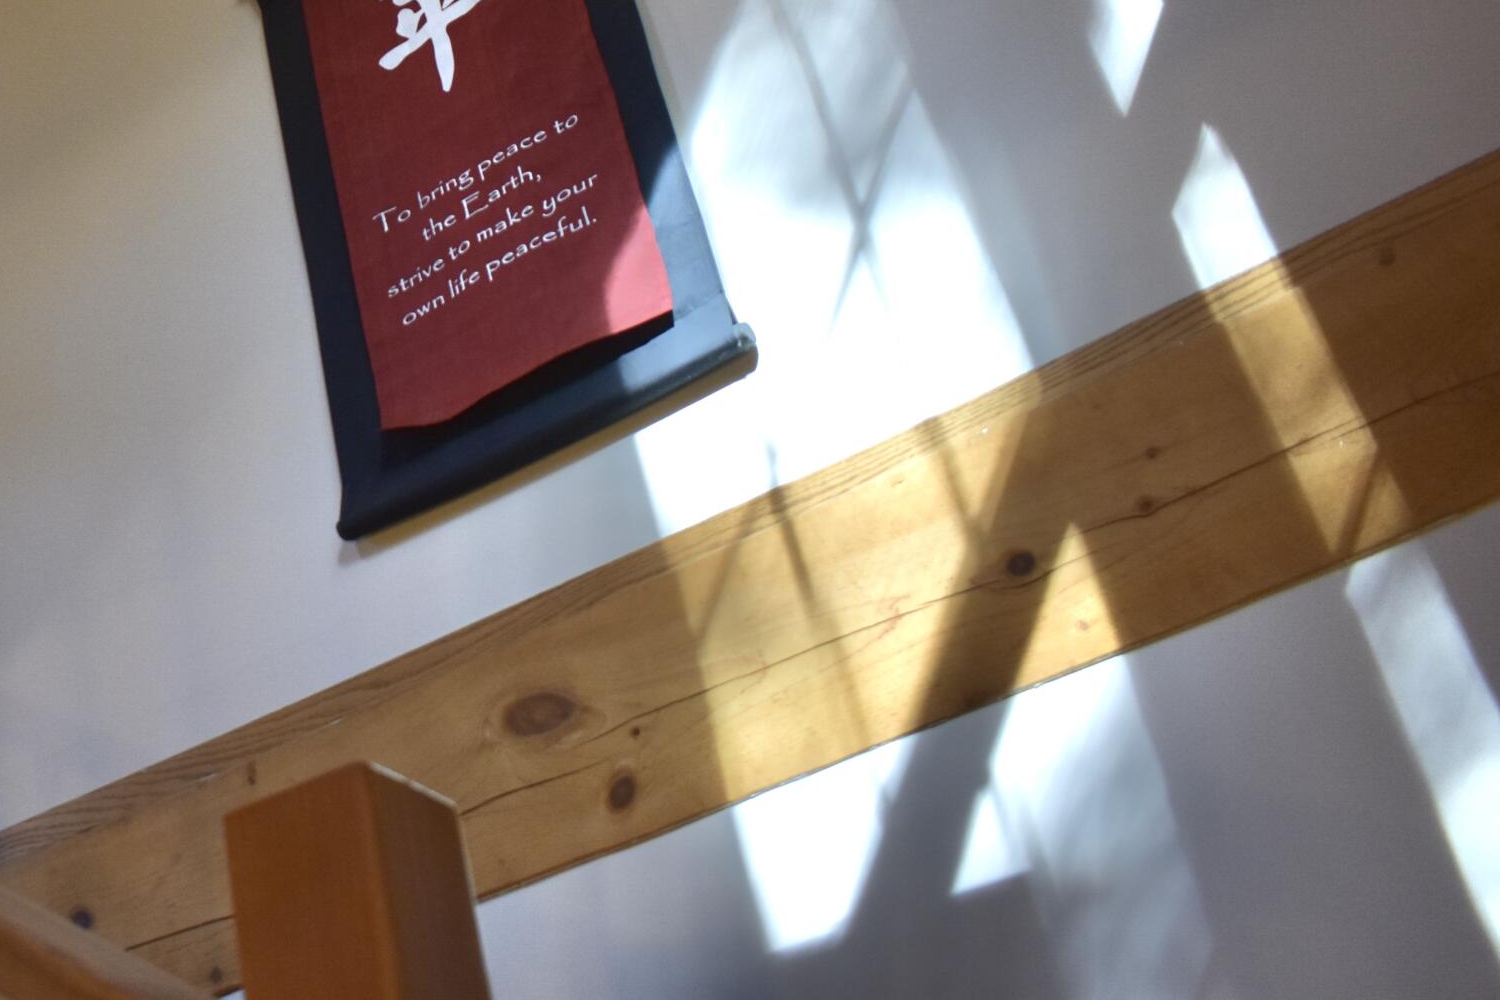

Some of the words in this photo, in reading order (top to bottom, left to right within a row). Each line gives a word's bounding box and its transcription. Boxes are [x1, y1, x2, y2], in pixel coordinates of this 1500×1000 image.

[372, 206, 412, 233] To
[417, 168, 474, 210] bring
[477, 130, 547, 181] peace
[553, 114, 578, 135] to
[422, 213, 457, 241] the
[461, 165, 542, 220] Earth,
[387, 258, 445, 298] strive
[448, 240, 471, 261] to
[476, 204, 534, 243] make
[542, 174, 598, 218] your
[402, 295, 445, 326] own
[448, 269, 480, 299] life
[486, 206, 597, 282] peaceful.
